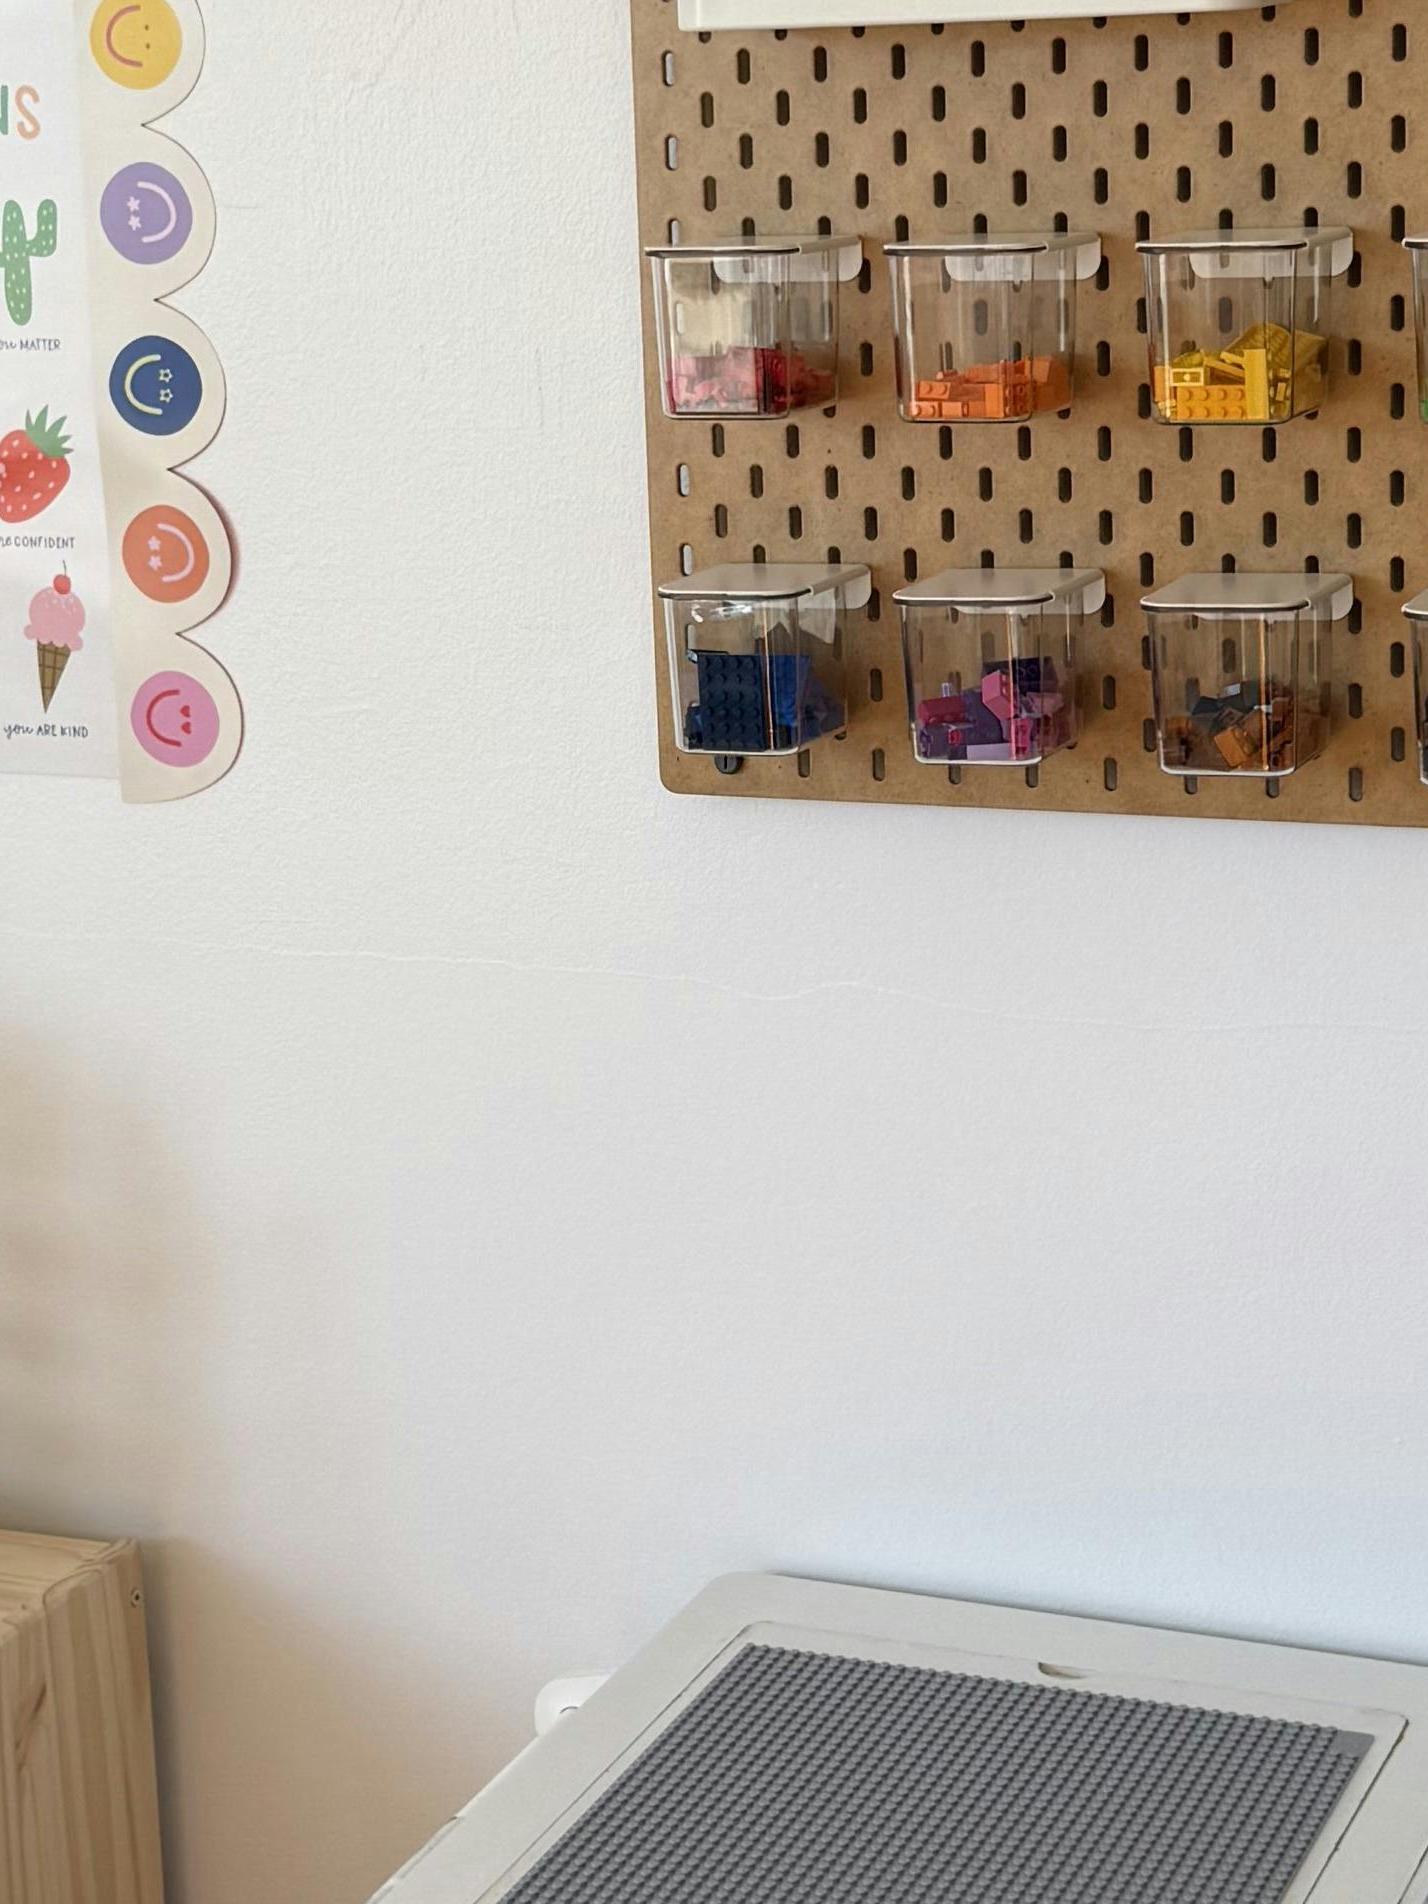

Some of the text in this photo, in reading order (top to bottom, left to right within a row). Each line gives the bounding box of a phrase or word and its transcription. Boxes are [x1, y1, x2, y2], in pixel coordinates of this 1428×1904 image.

[19, 338, 61, 351] MATTER
[14, 535, 75, 549] CONFIDENT
[4, 724, 89, 740] you ARE KIND
